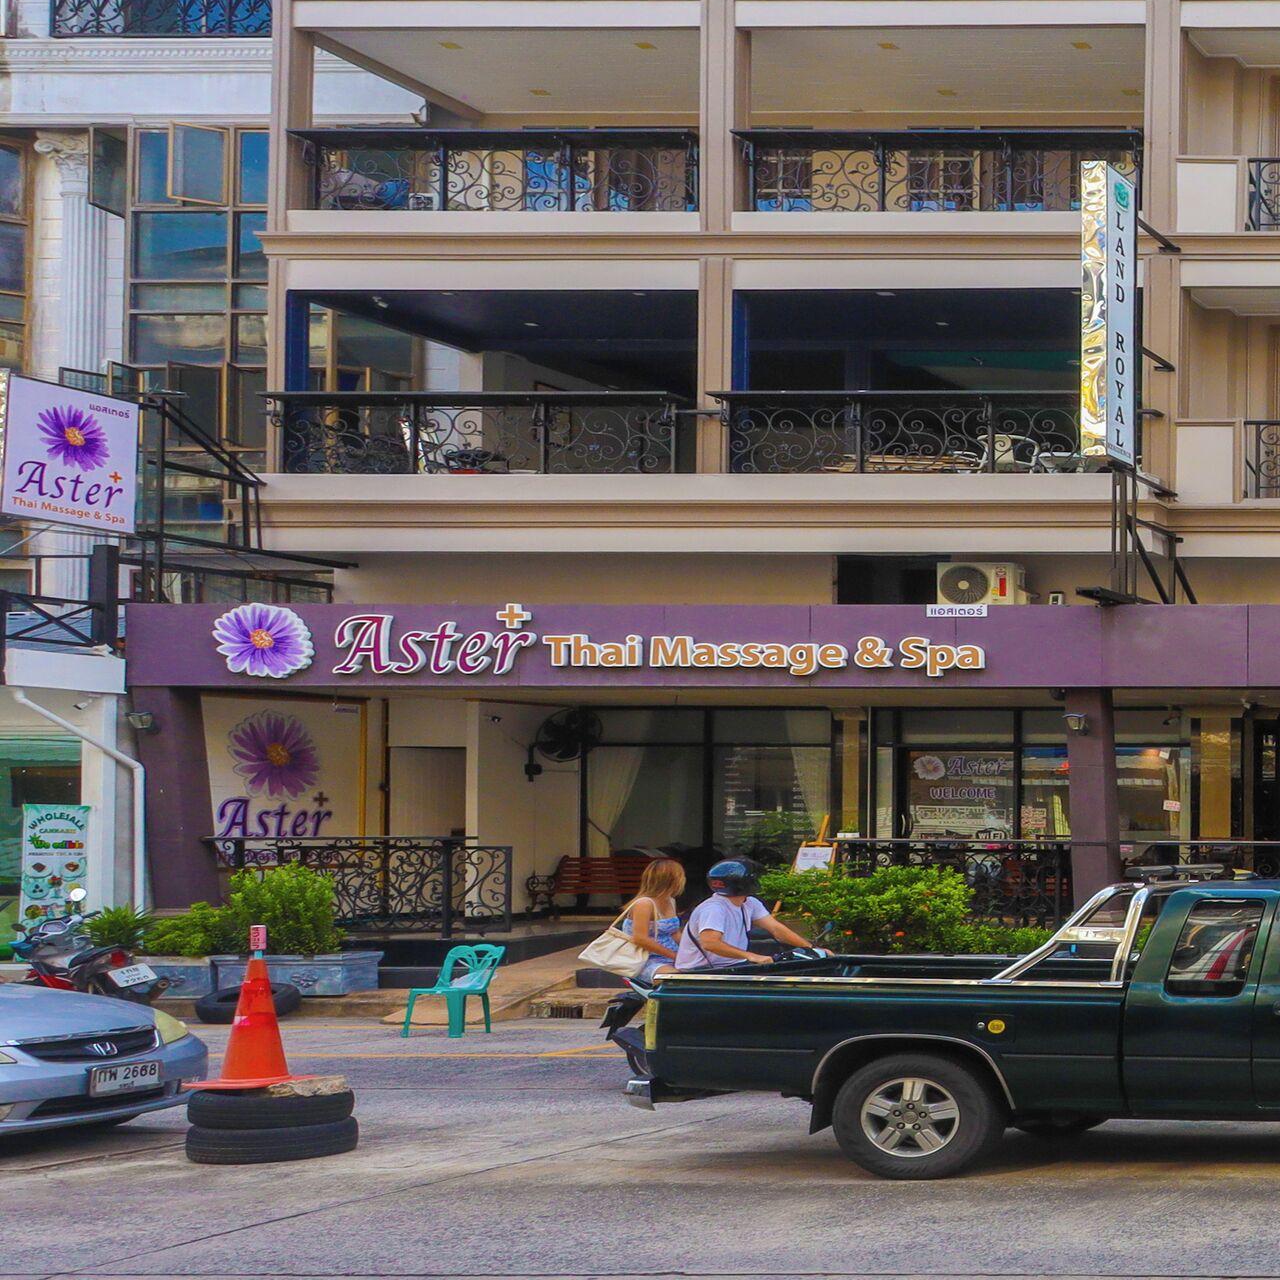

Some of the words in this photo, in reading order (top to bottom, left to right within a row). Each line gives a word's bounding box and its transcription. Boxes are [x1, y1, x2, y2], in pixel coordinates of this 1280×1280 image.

[1113, 211, 1127, 304] LAND
[1113, 331, 1127, 449] ROYAL
[89, 403, 130, 419] แอสเตอร์
[15, 461, 124, 508] Aster
[12, 496, 38, 510] Thai
[40, 501, 91, 519] Massage
[93, 510, 103, 520] &
[105, 513, 126, 525] Spa
[930, 605, 983, 616] แอสเตอร์
[332, 613, 536, 676] Aster
[543, 634, 642, 668] Thai
[649, 635, 849, 675] Massage
[853, 635, 893, 668] &
[899, 636, 987, 677] Spa
[947, 756, 1008, 775] Aster
[929, 786, 997, 800] WELCOME
[216, 796, 333, 837] Aster
